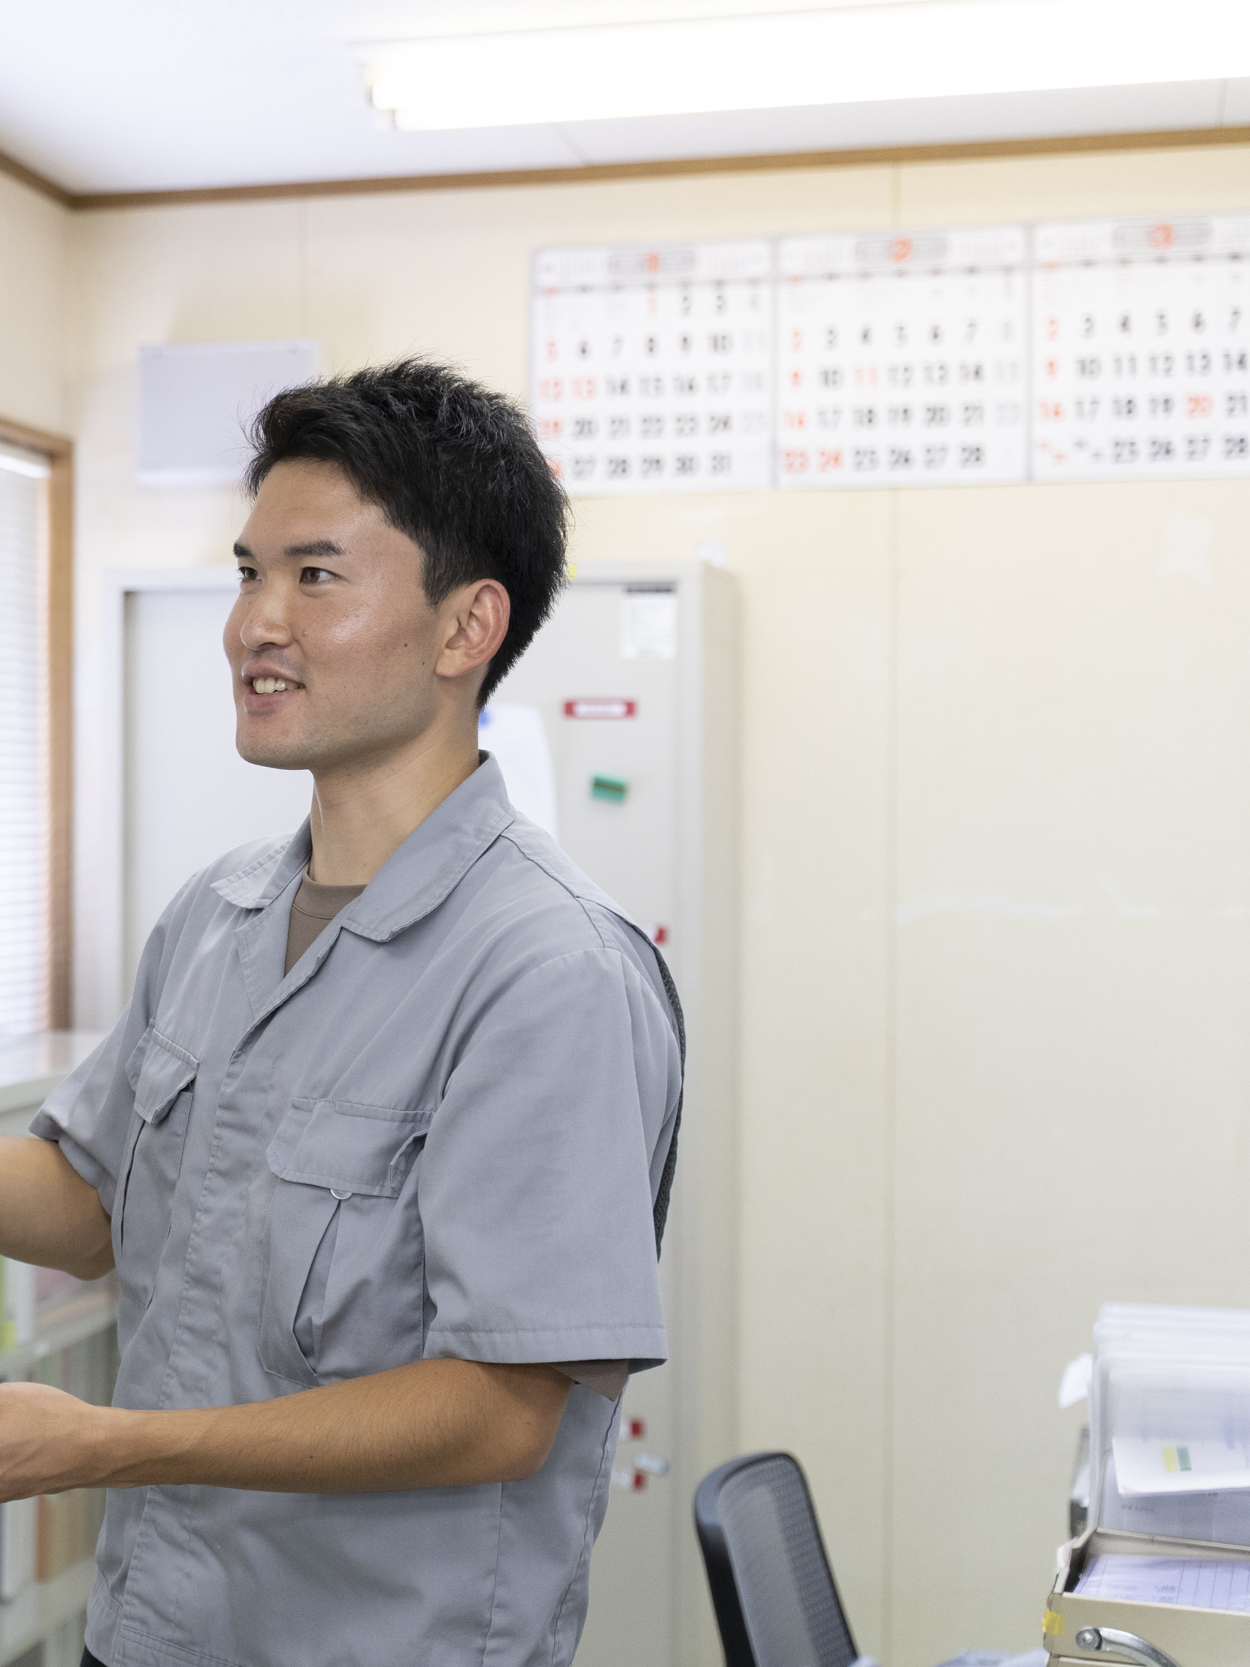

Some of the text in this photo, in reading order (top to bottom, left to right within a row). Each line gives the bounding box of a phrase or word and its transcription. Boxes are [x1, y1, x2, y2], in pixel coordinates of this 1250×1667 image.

[889, 234, 913, 263] 2
[1149, 222, 1174, 249] 3
[1112, 352, 1136, 379] 11
[1148, 351, 1173, 379] 12
[1184, 350, 1211, 378] 13
[1073, 395, 1100, 423] 17
[1109, 394, 1136, 421] 18
[1183, 433, 1211, 462] 27
